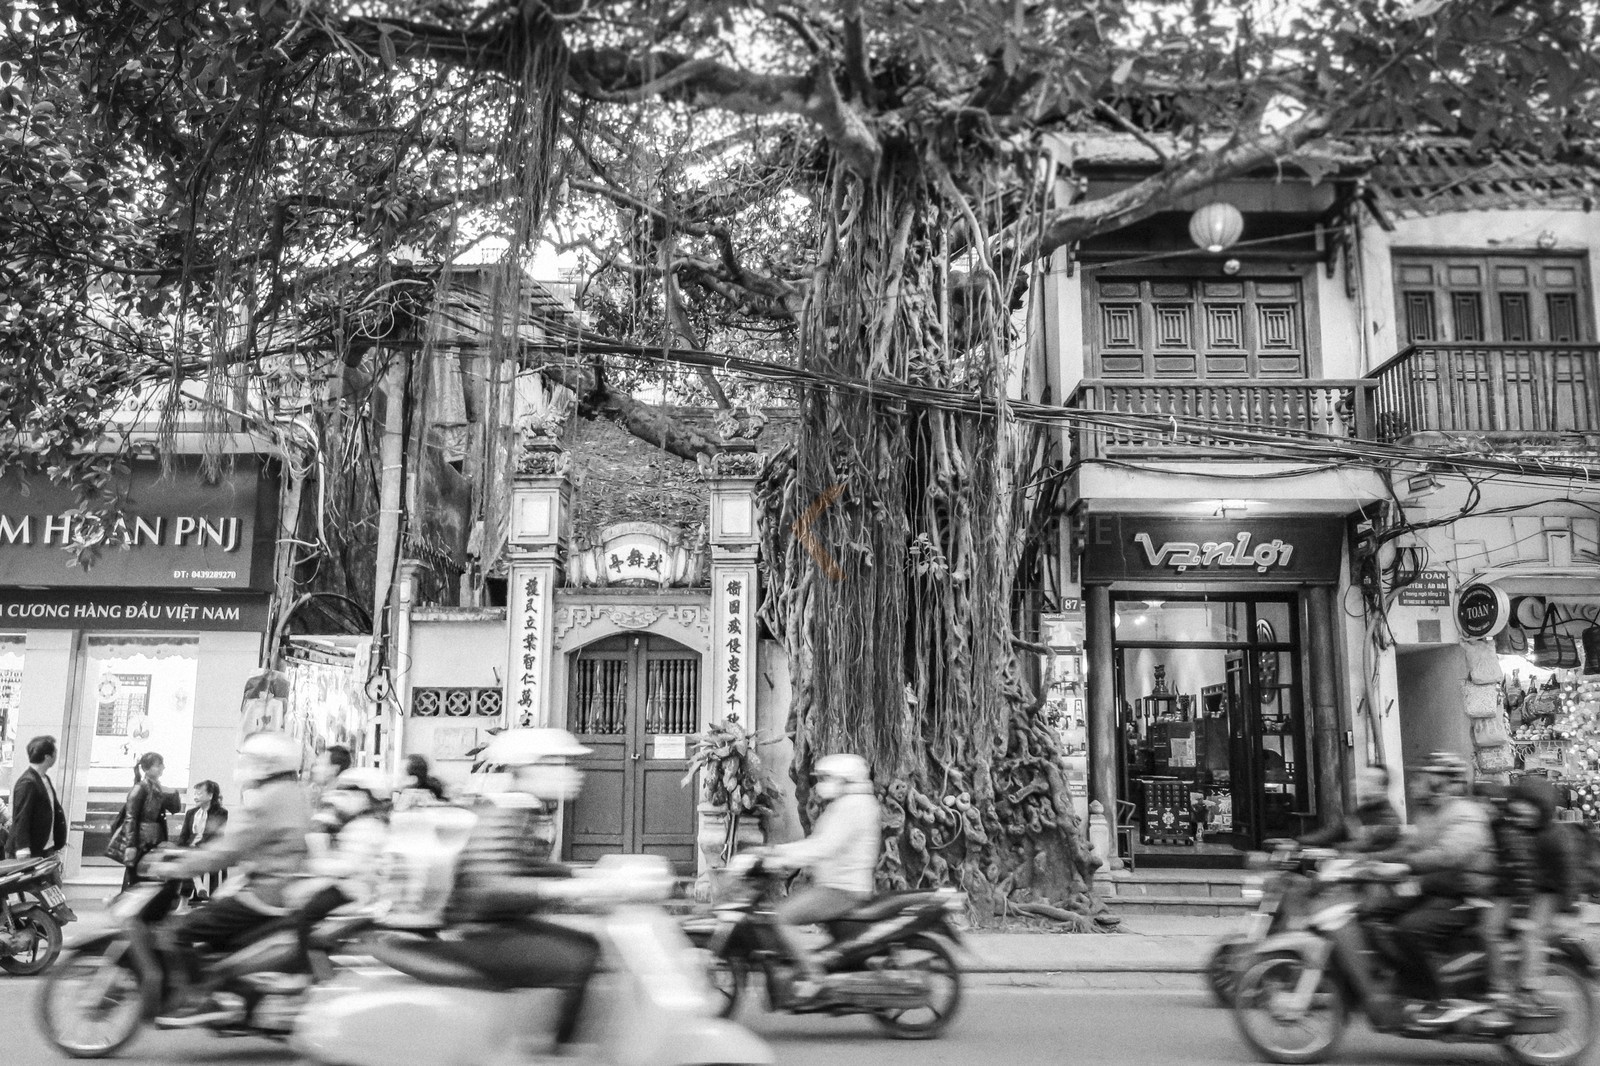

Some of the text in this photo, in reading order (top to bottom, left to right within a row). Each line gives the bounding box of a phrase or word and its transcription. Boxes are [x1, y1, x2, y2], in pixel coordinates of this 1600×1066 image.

[174, 516, 240, 552] PNJ
[173, 570, 237, 579] ĐT: 0439289270
[7, 603, 70, 618] CƯƠNG
[74, 602, 121, 618] HÀNG
[125, 600, 161, 619] ĐẦU
[165, 603, 199, 622] VIỆT
[202, 607, 240, 620] NAM
[1064, 599, 1078, 610] 87
